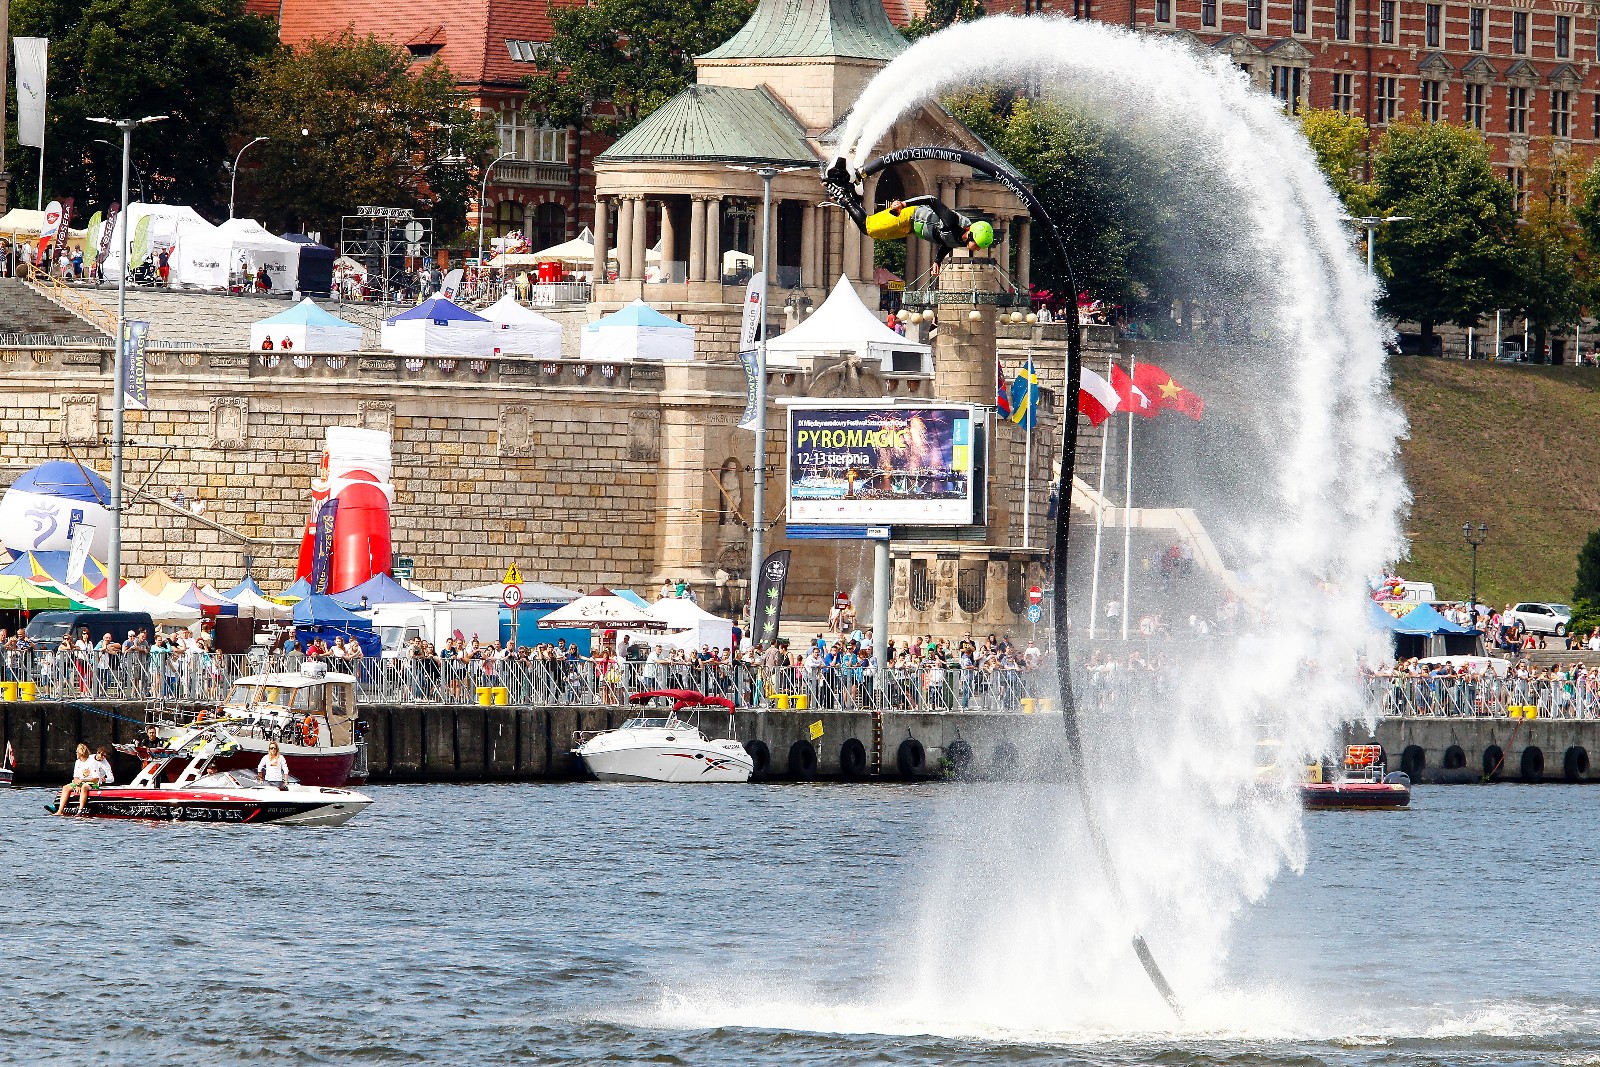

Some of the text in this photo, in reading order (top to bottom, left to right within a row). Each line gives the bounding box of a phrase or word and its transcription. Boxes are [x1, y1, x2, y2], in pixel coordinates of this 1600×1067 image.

[746, 309, 755, 345] Szczecin
[135, 328, 147, 400] PYROMAGIC
[797, 430, 907, 449] PYROMAGIC
[797, 452, 870, 467] 12-13 sierpnia
[506, 591, 519, 602] 40
